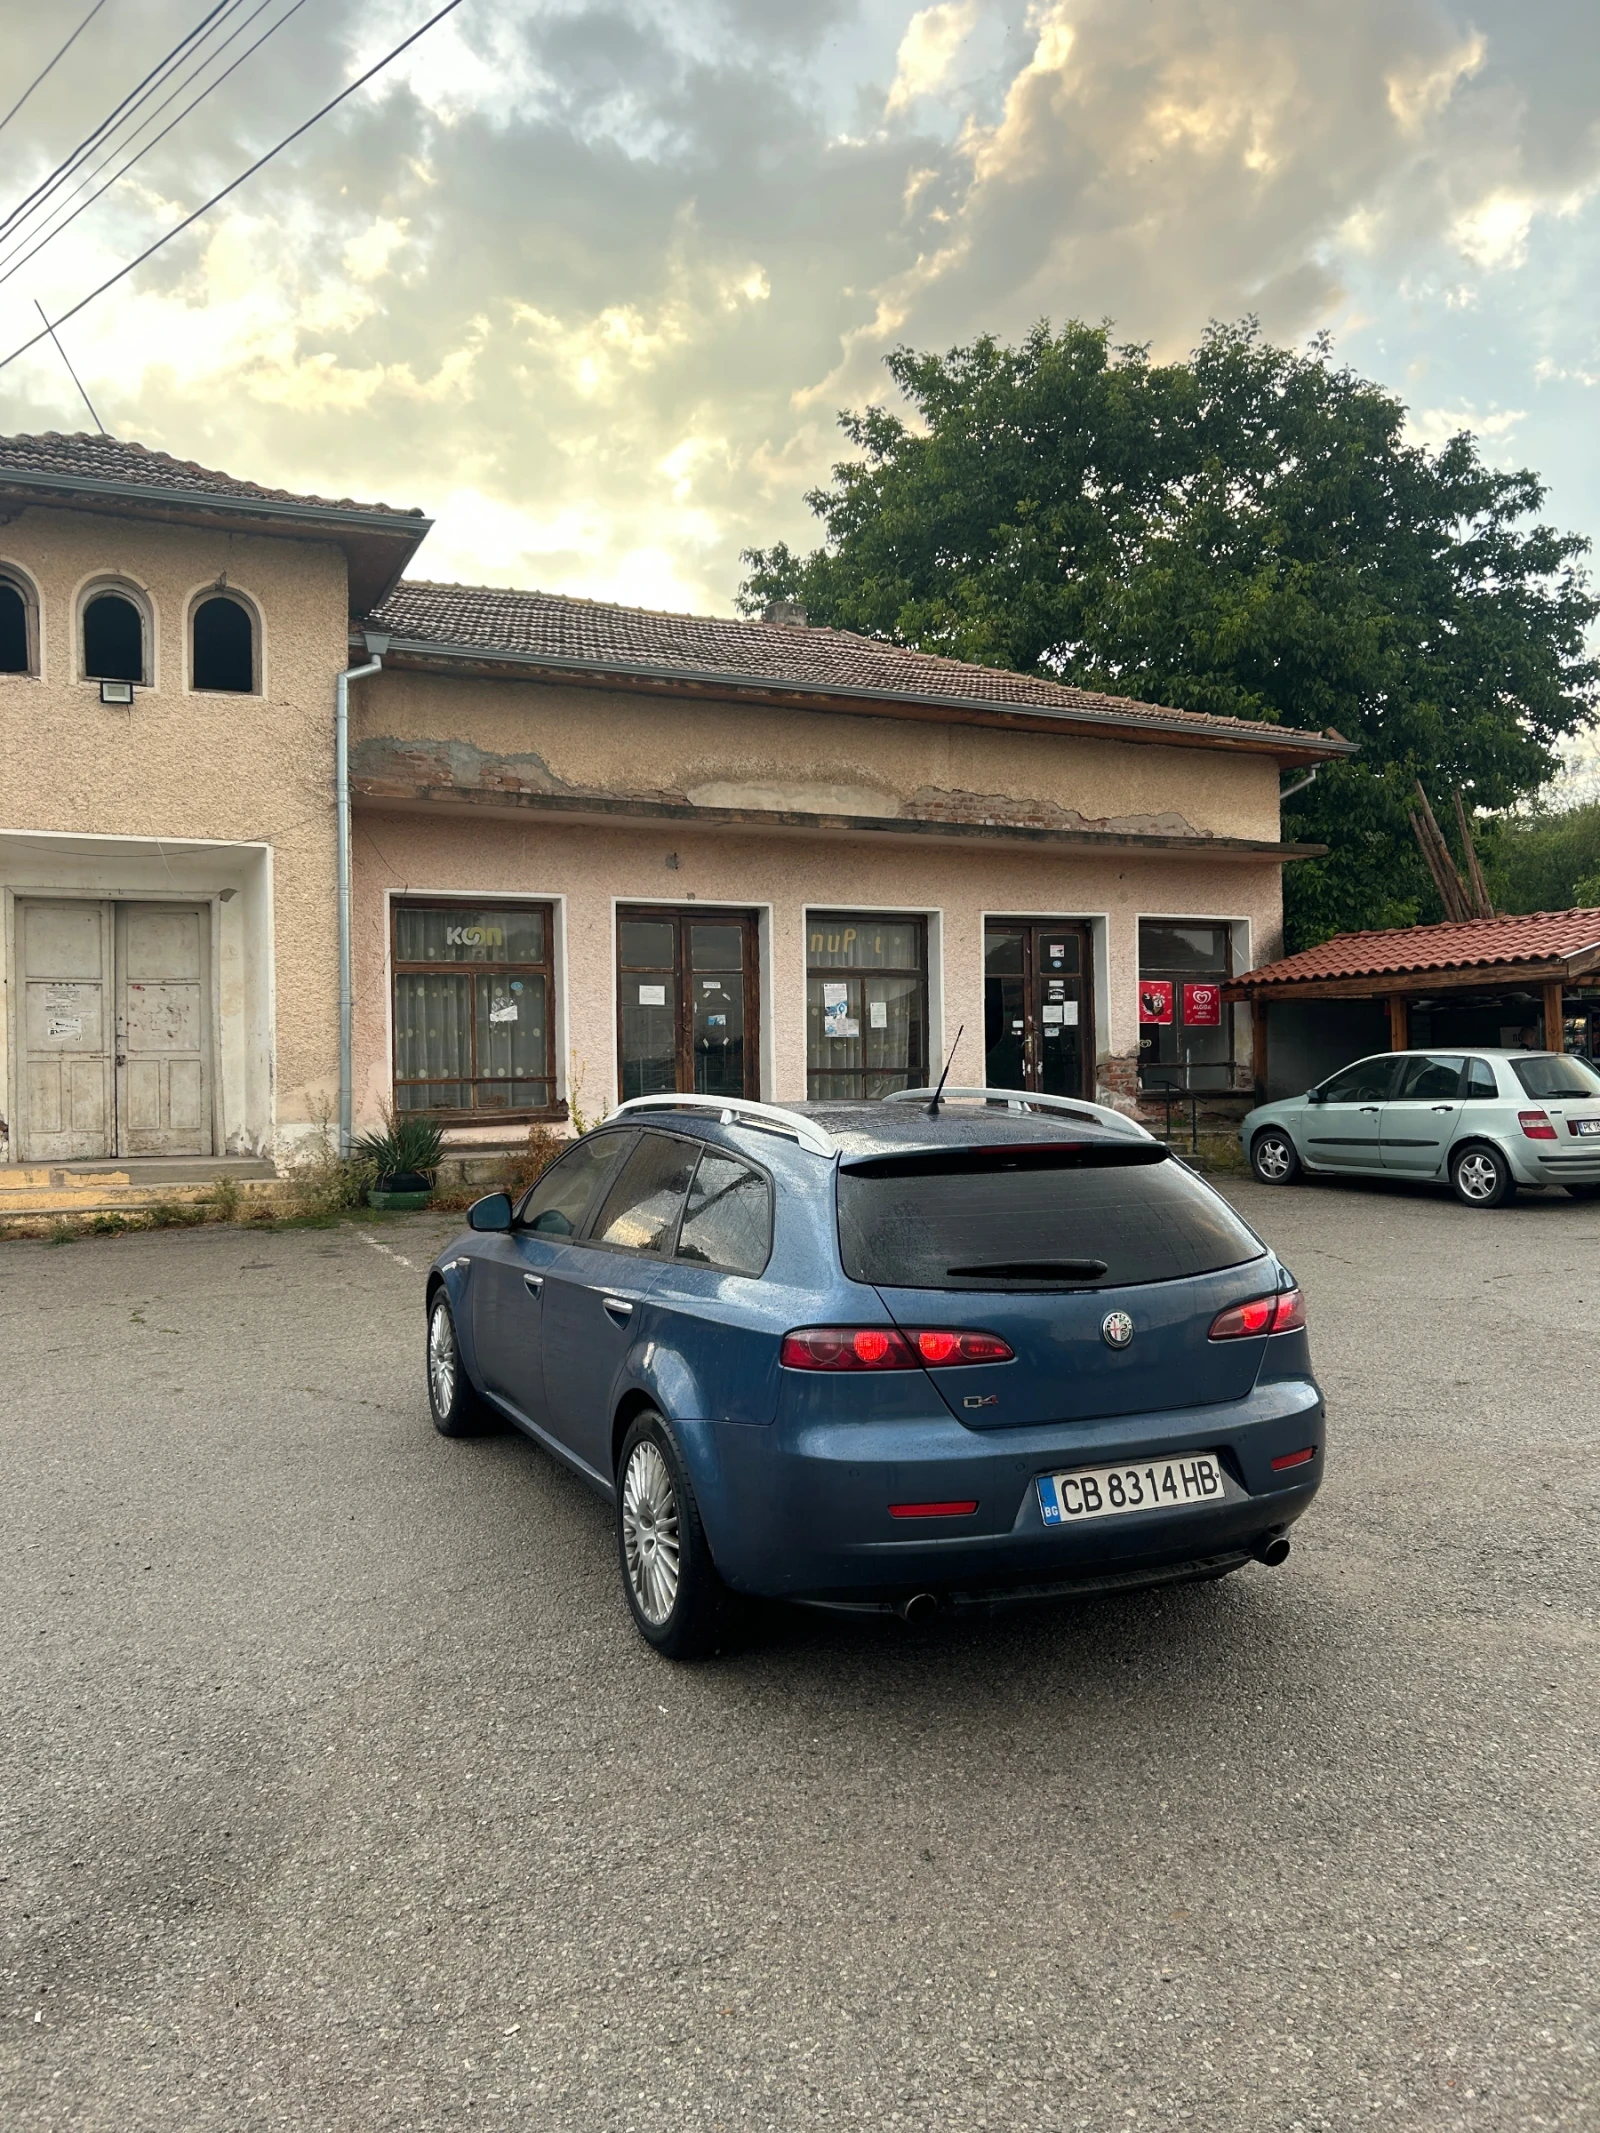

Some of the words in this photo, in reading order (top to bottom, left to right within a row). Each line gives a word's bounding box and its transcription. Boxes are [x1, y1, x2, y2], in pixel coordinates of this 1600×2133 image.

[1061, 1476, 1103, 1515] CB
[1107, 1465, 1178, 1508] 8314
[1179, 1460, 1218, 1498] HB
[1044, 1506, 1059, 1518] BG
